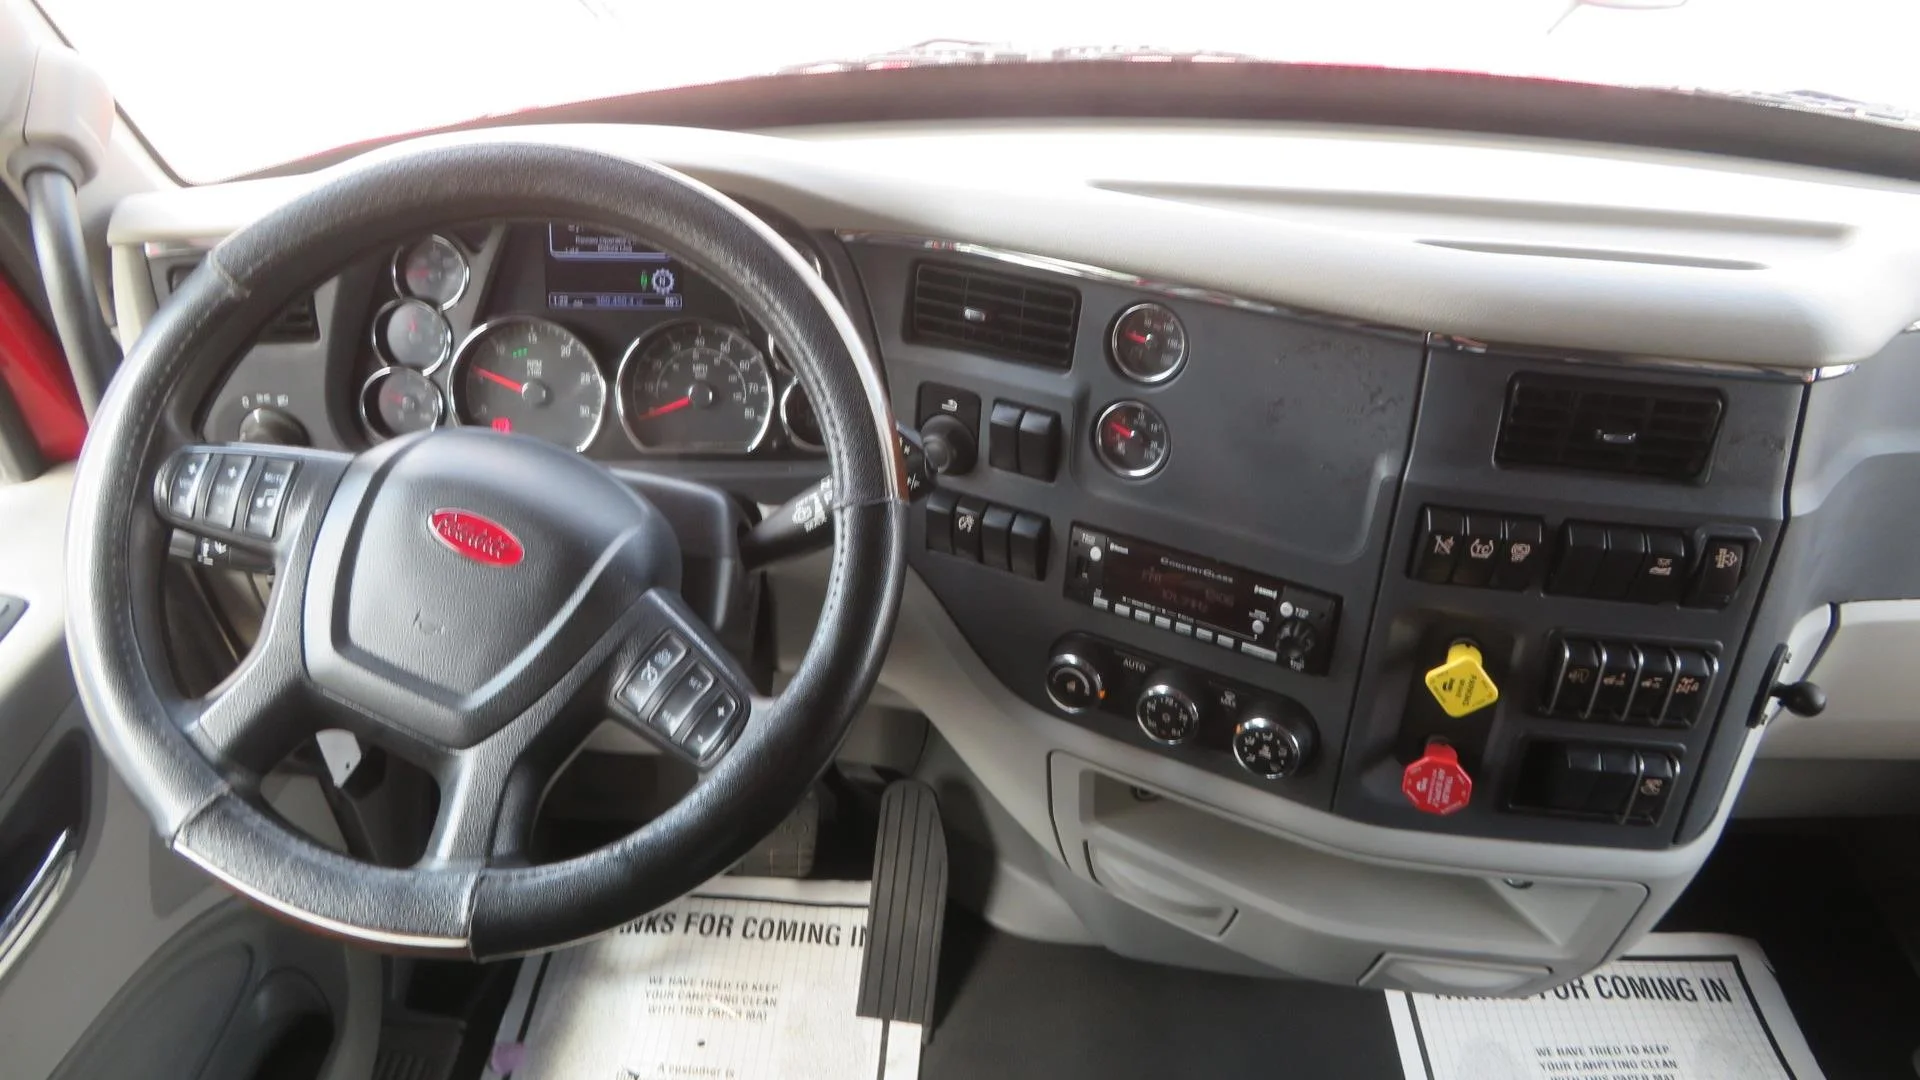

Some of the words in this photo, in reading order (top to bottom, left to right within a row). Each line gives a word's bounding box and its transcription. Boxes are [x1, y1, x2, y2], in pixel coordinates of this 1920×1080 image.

[1123, 658, 1146, 673] AUTO
[619, 912, 676, 935] NKS
[684, 912, 734, 938] FOR
[742, 916, 841, 947] COMING
[1595, 973, 1698, 1003] COMING
[1704, 977, 1733, 1003] IN
[1536, 1047, 1552, 1057] WE
[1556, 1046, 1583, 1057] HAVE
[1589, 1045, 1620, 1057] TRIED
[1625, 1045, 1639, 1055] TO
[1642, 1044, 1669, 1055] KEEP
[1540, 1061, 1571, 1072] YOUR
[1575, 1060, 1638, 1072] CARPETING
[1641, 1059, 1678, 1070] CLEAN
